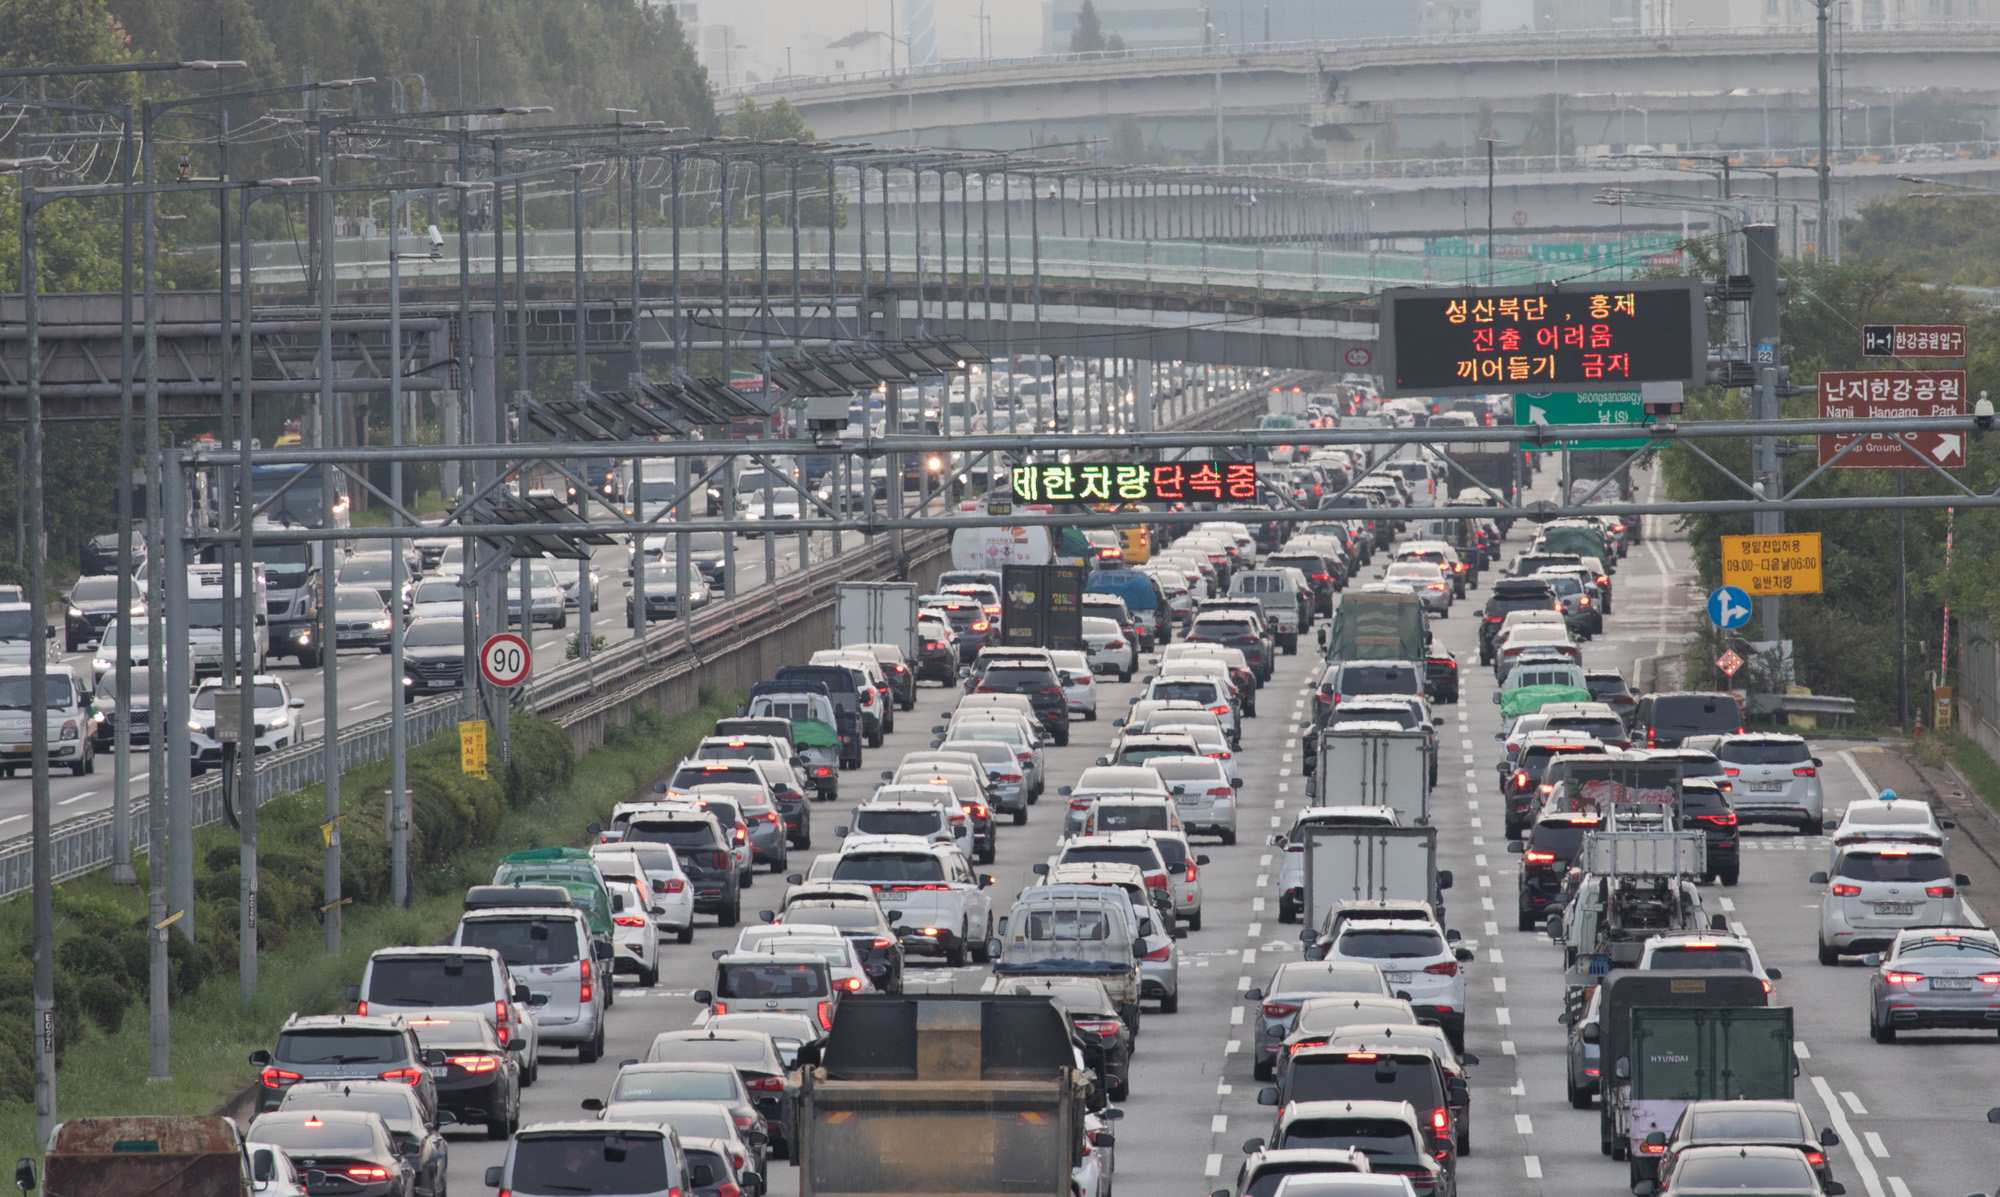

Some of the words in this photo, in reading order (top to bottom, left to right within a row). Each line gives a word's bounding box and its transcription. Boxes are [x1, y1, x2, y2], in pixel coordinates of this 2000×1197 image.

[1446, 297, 1548, 323] 성산북단
[1588, 293, 1634, 319] 홍제
[1472, 327, 1521, 351] 진출
[1536, 324, 1612, 350] 어려움
[1866, 332, 1892, 349] H-1
[1896, 332, 1962, 350] 한강공원입구
[1760, 352, 1771, 361] 22
[1457, 355, 1555, 382] 끼어들기
[1582, 353, 1629, 378] 금지
[1826, 378, 1959, 401] 난지한강공원
[1932, 405, 1957, 416] Park
[1866, 443, 1902, 452] Ground
[1752, 575, 1792, 589] 일반차량
[494, 648, 520, 673] 90
[1650, 1055, 1689, 1063] HYUNDAI
